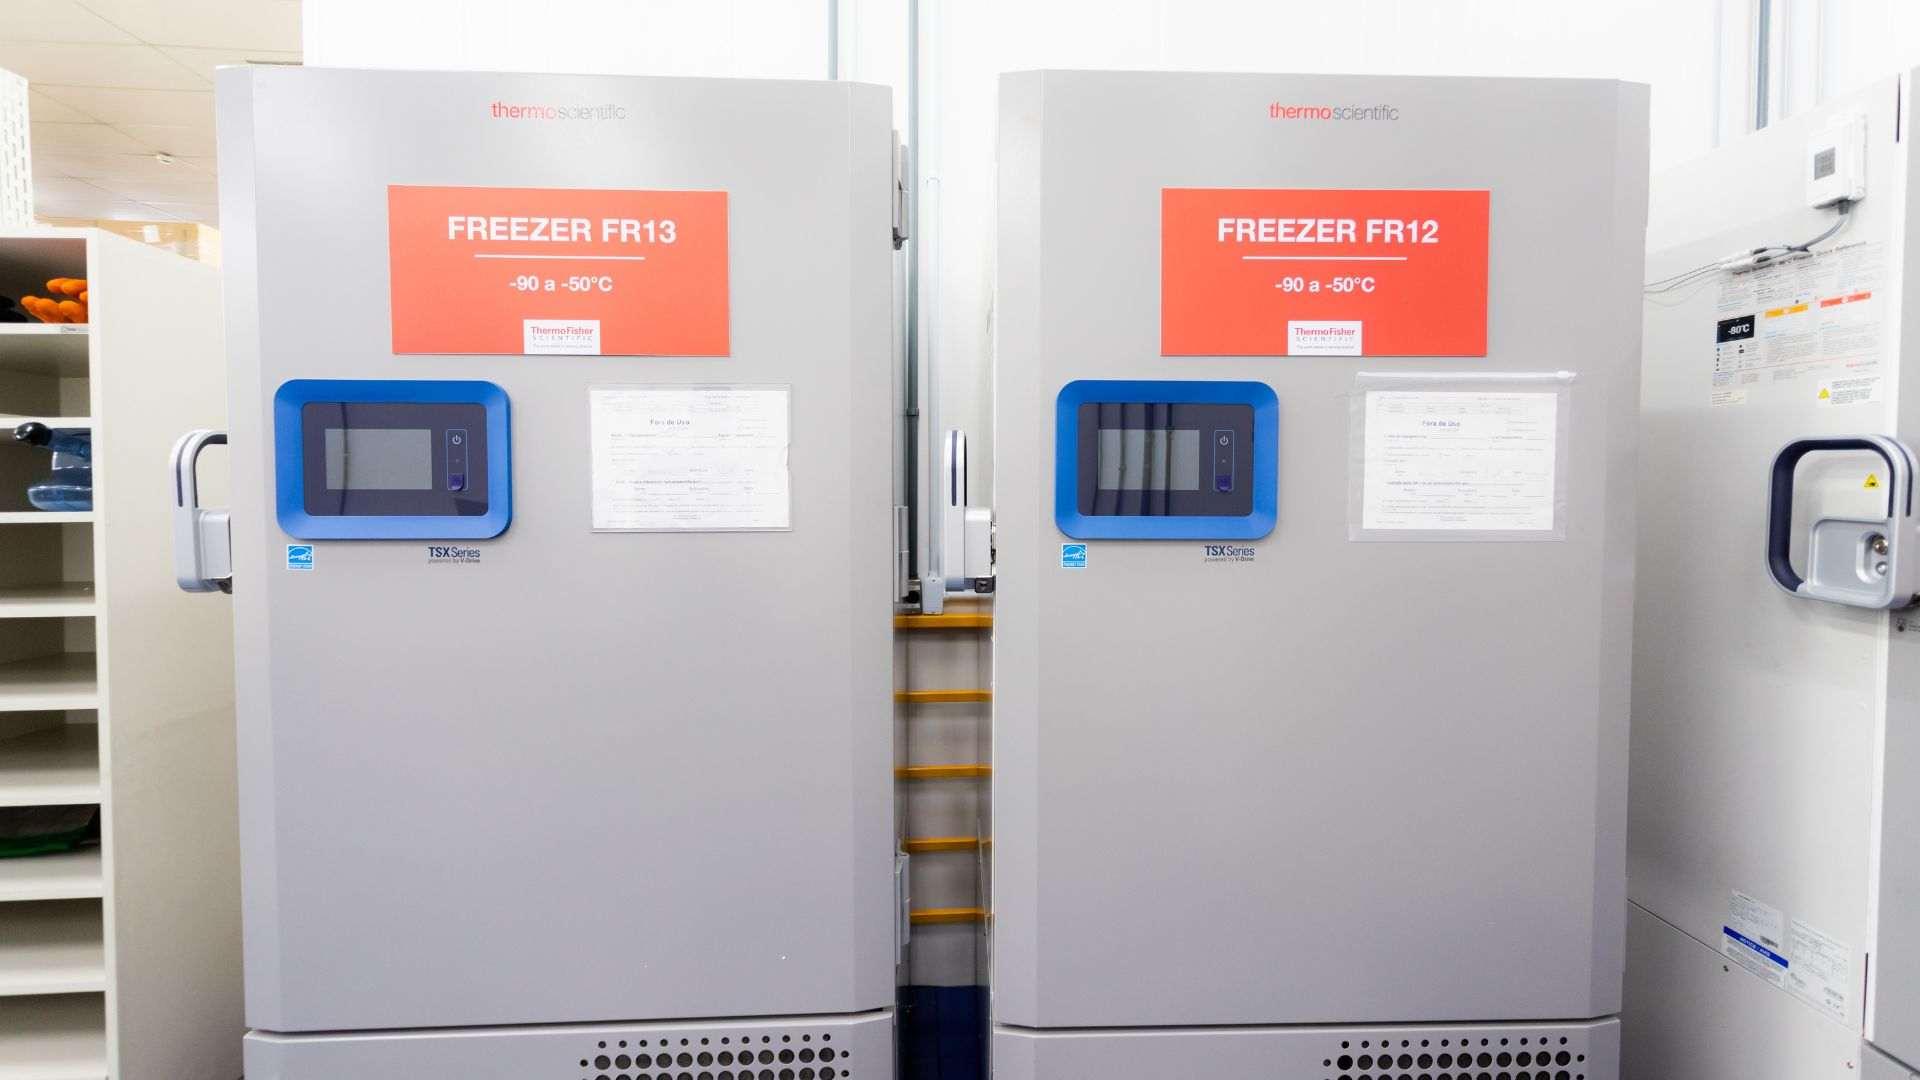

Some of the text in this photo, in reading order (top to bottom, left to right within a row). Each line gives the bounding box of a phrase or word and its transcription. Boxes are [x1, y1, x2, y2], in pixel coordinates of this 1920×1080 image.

[447, 215, 677, 244] FREEZER FR13
[1217, 218, 1440, 244] FREEZER FR12
[509, 275, 613, 292] -90 a -50°C
[1275, 276, 1376, 293] -90 a -50°C
[530, 326, 594, 335] ThermoFisher
[1294, 327, 1356, 336] ThermoFisher
